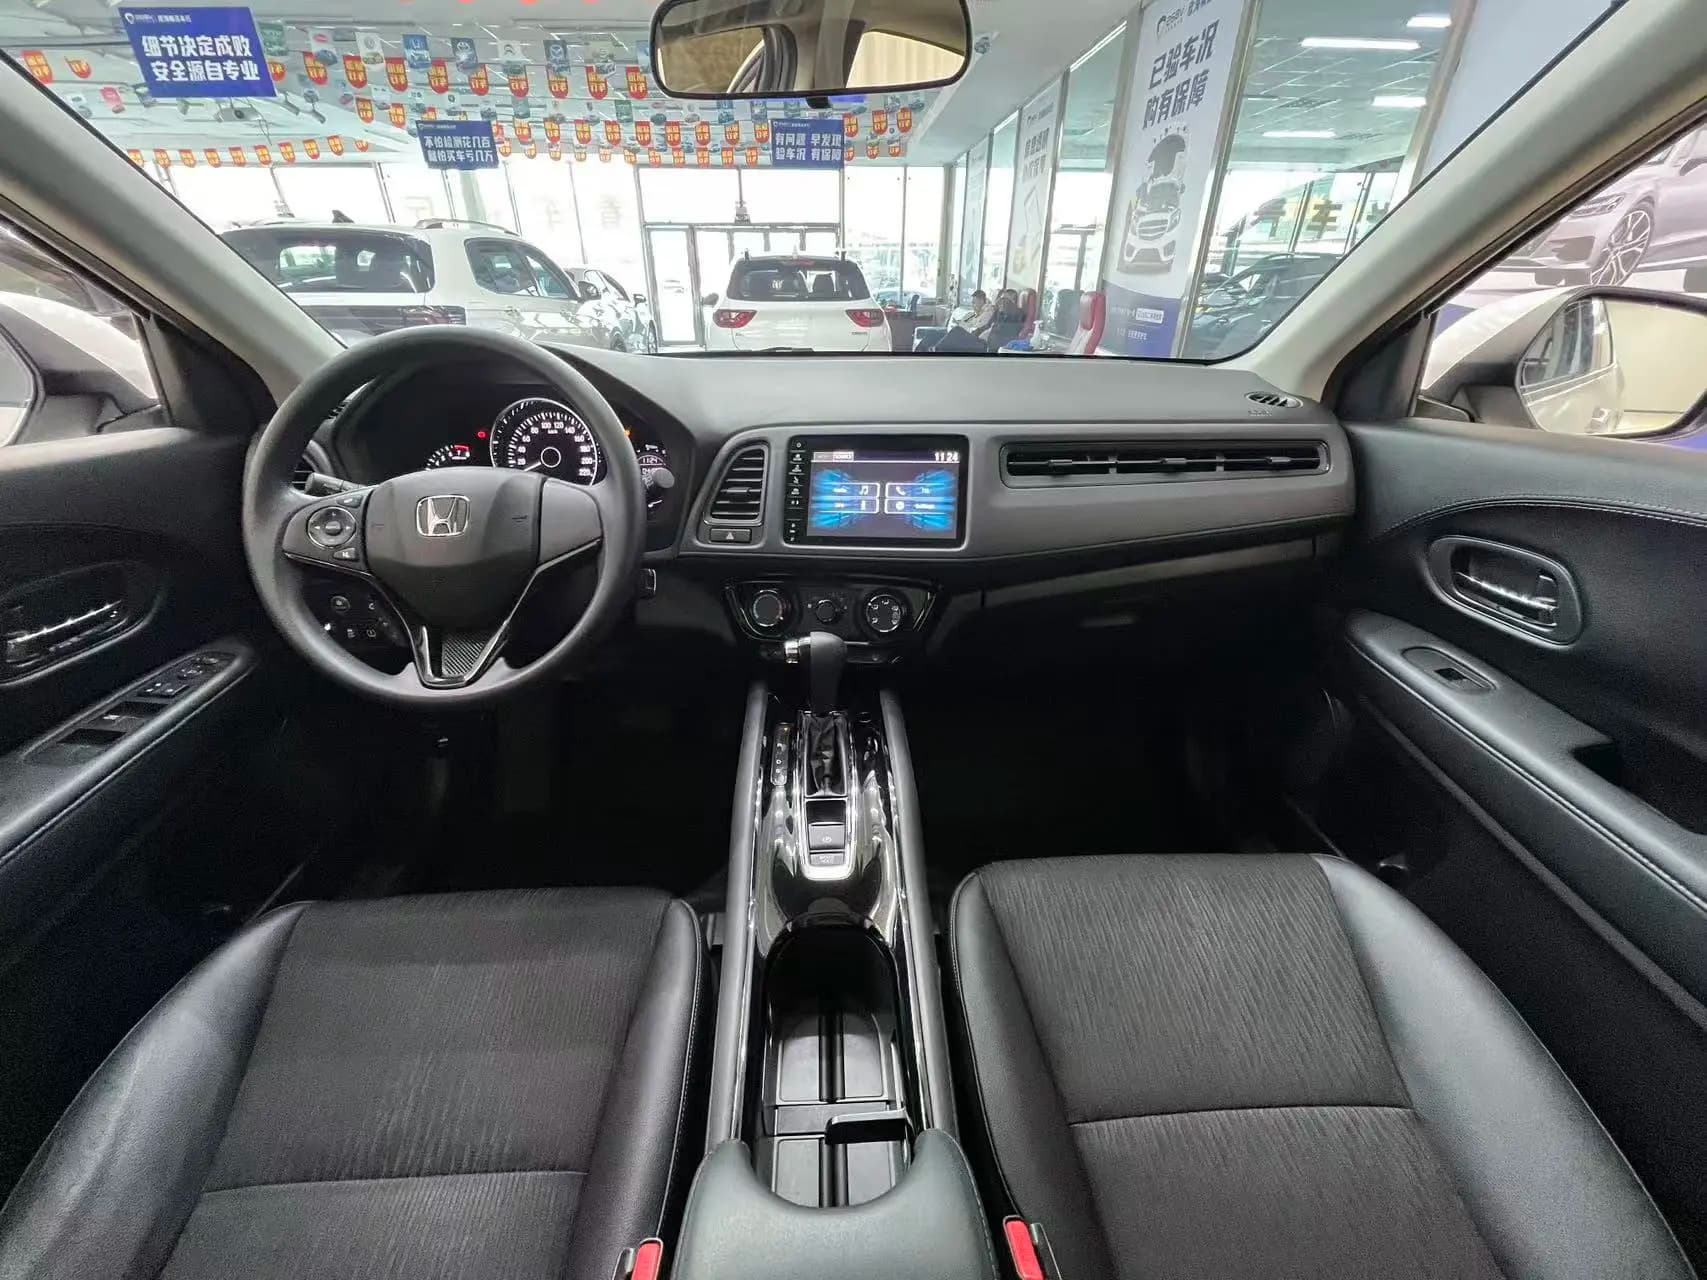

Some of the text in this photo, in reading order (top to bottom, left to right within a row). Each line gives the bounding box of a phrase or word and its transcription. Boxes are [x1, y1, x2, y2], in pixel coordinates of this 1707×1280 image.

[141, 35, 252, 57] 细节决定成败
[1148, 19, 1220, 90] 已验车况
[151, 60, 261, 82] 安全源自专业
[1142, 69, 1209, 130] 购有保障
[517, 458, 526, 466] 20
